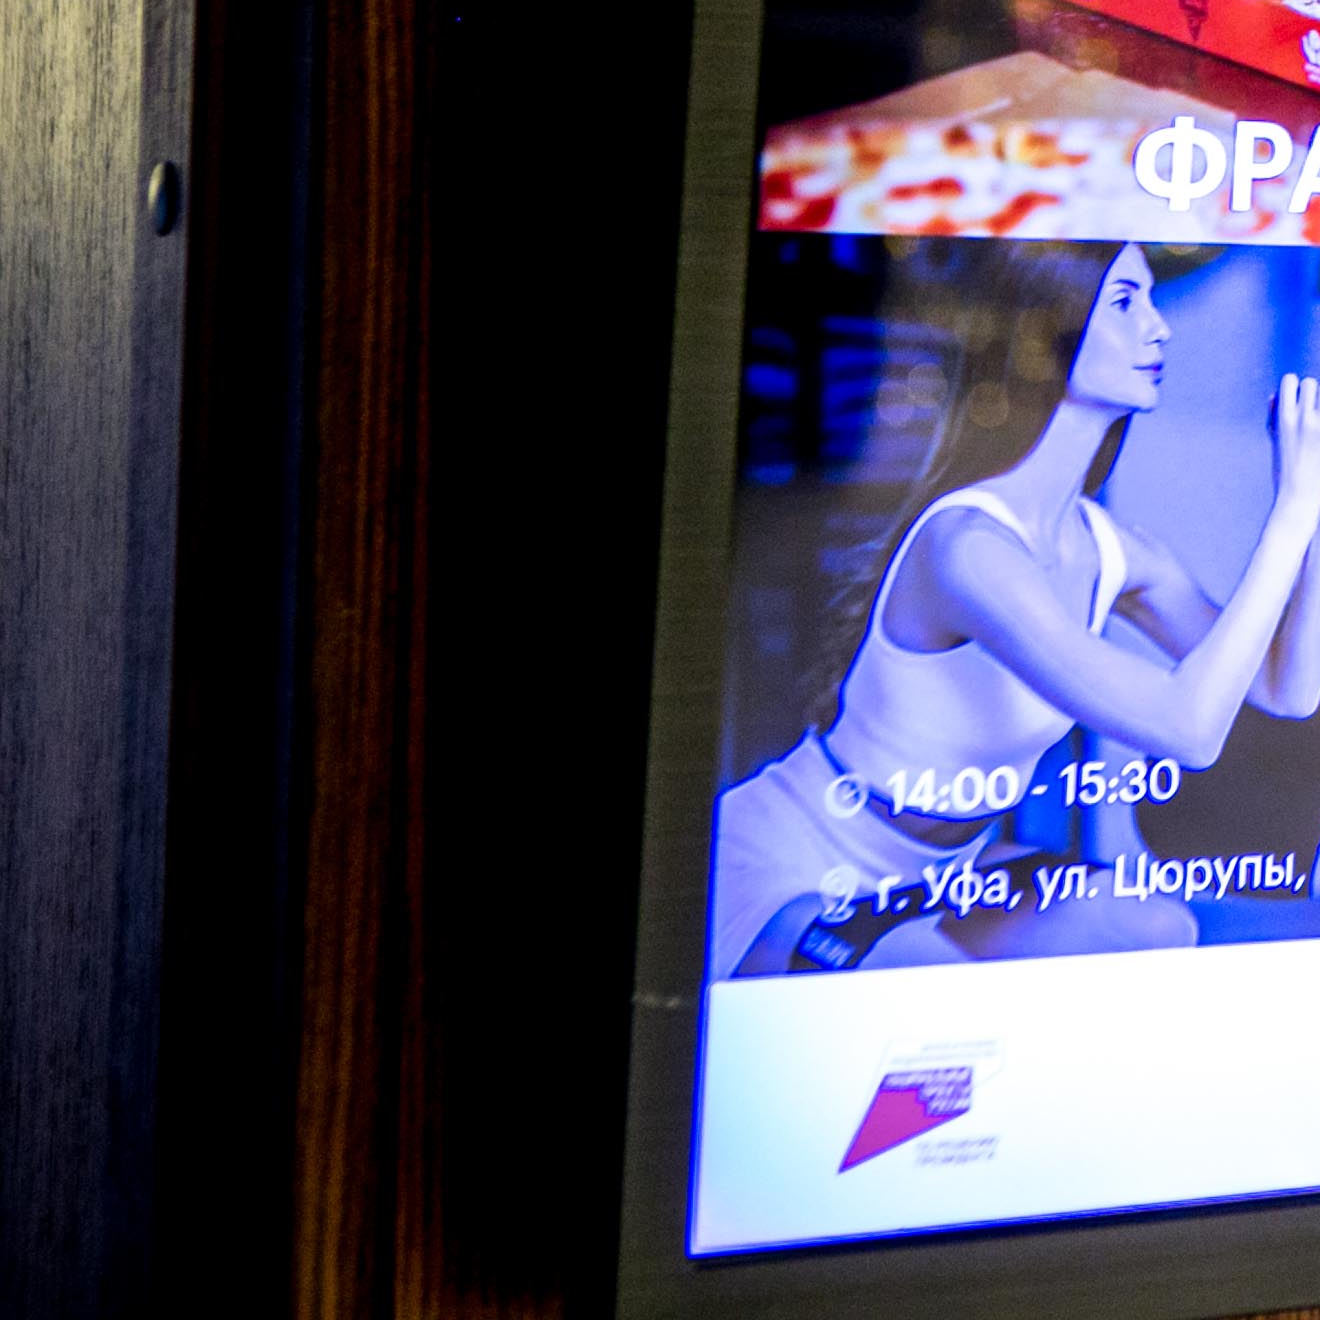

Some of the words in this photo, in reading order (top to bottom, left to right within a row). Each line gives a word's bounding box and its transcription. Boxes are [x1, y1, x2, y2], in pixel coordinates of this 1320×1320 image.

[886, 765, 1020, 816] 14:00
[1030, 783, 1049, 796] -
[1058, 758, 1181, 807] 15:30
[876, 874, 910, 913] г.
[921, 858, 1024, 918] Уфа,
[1032, 863, 1099, 913] ул.
[1114, 851, 1306, 902] Цюрупы,
